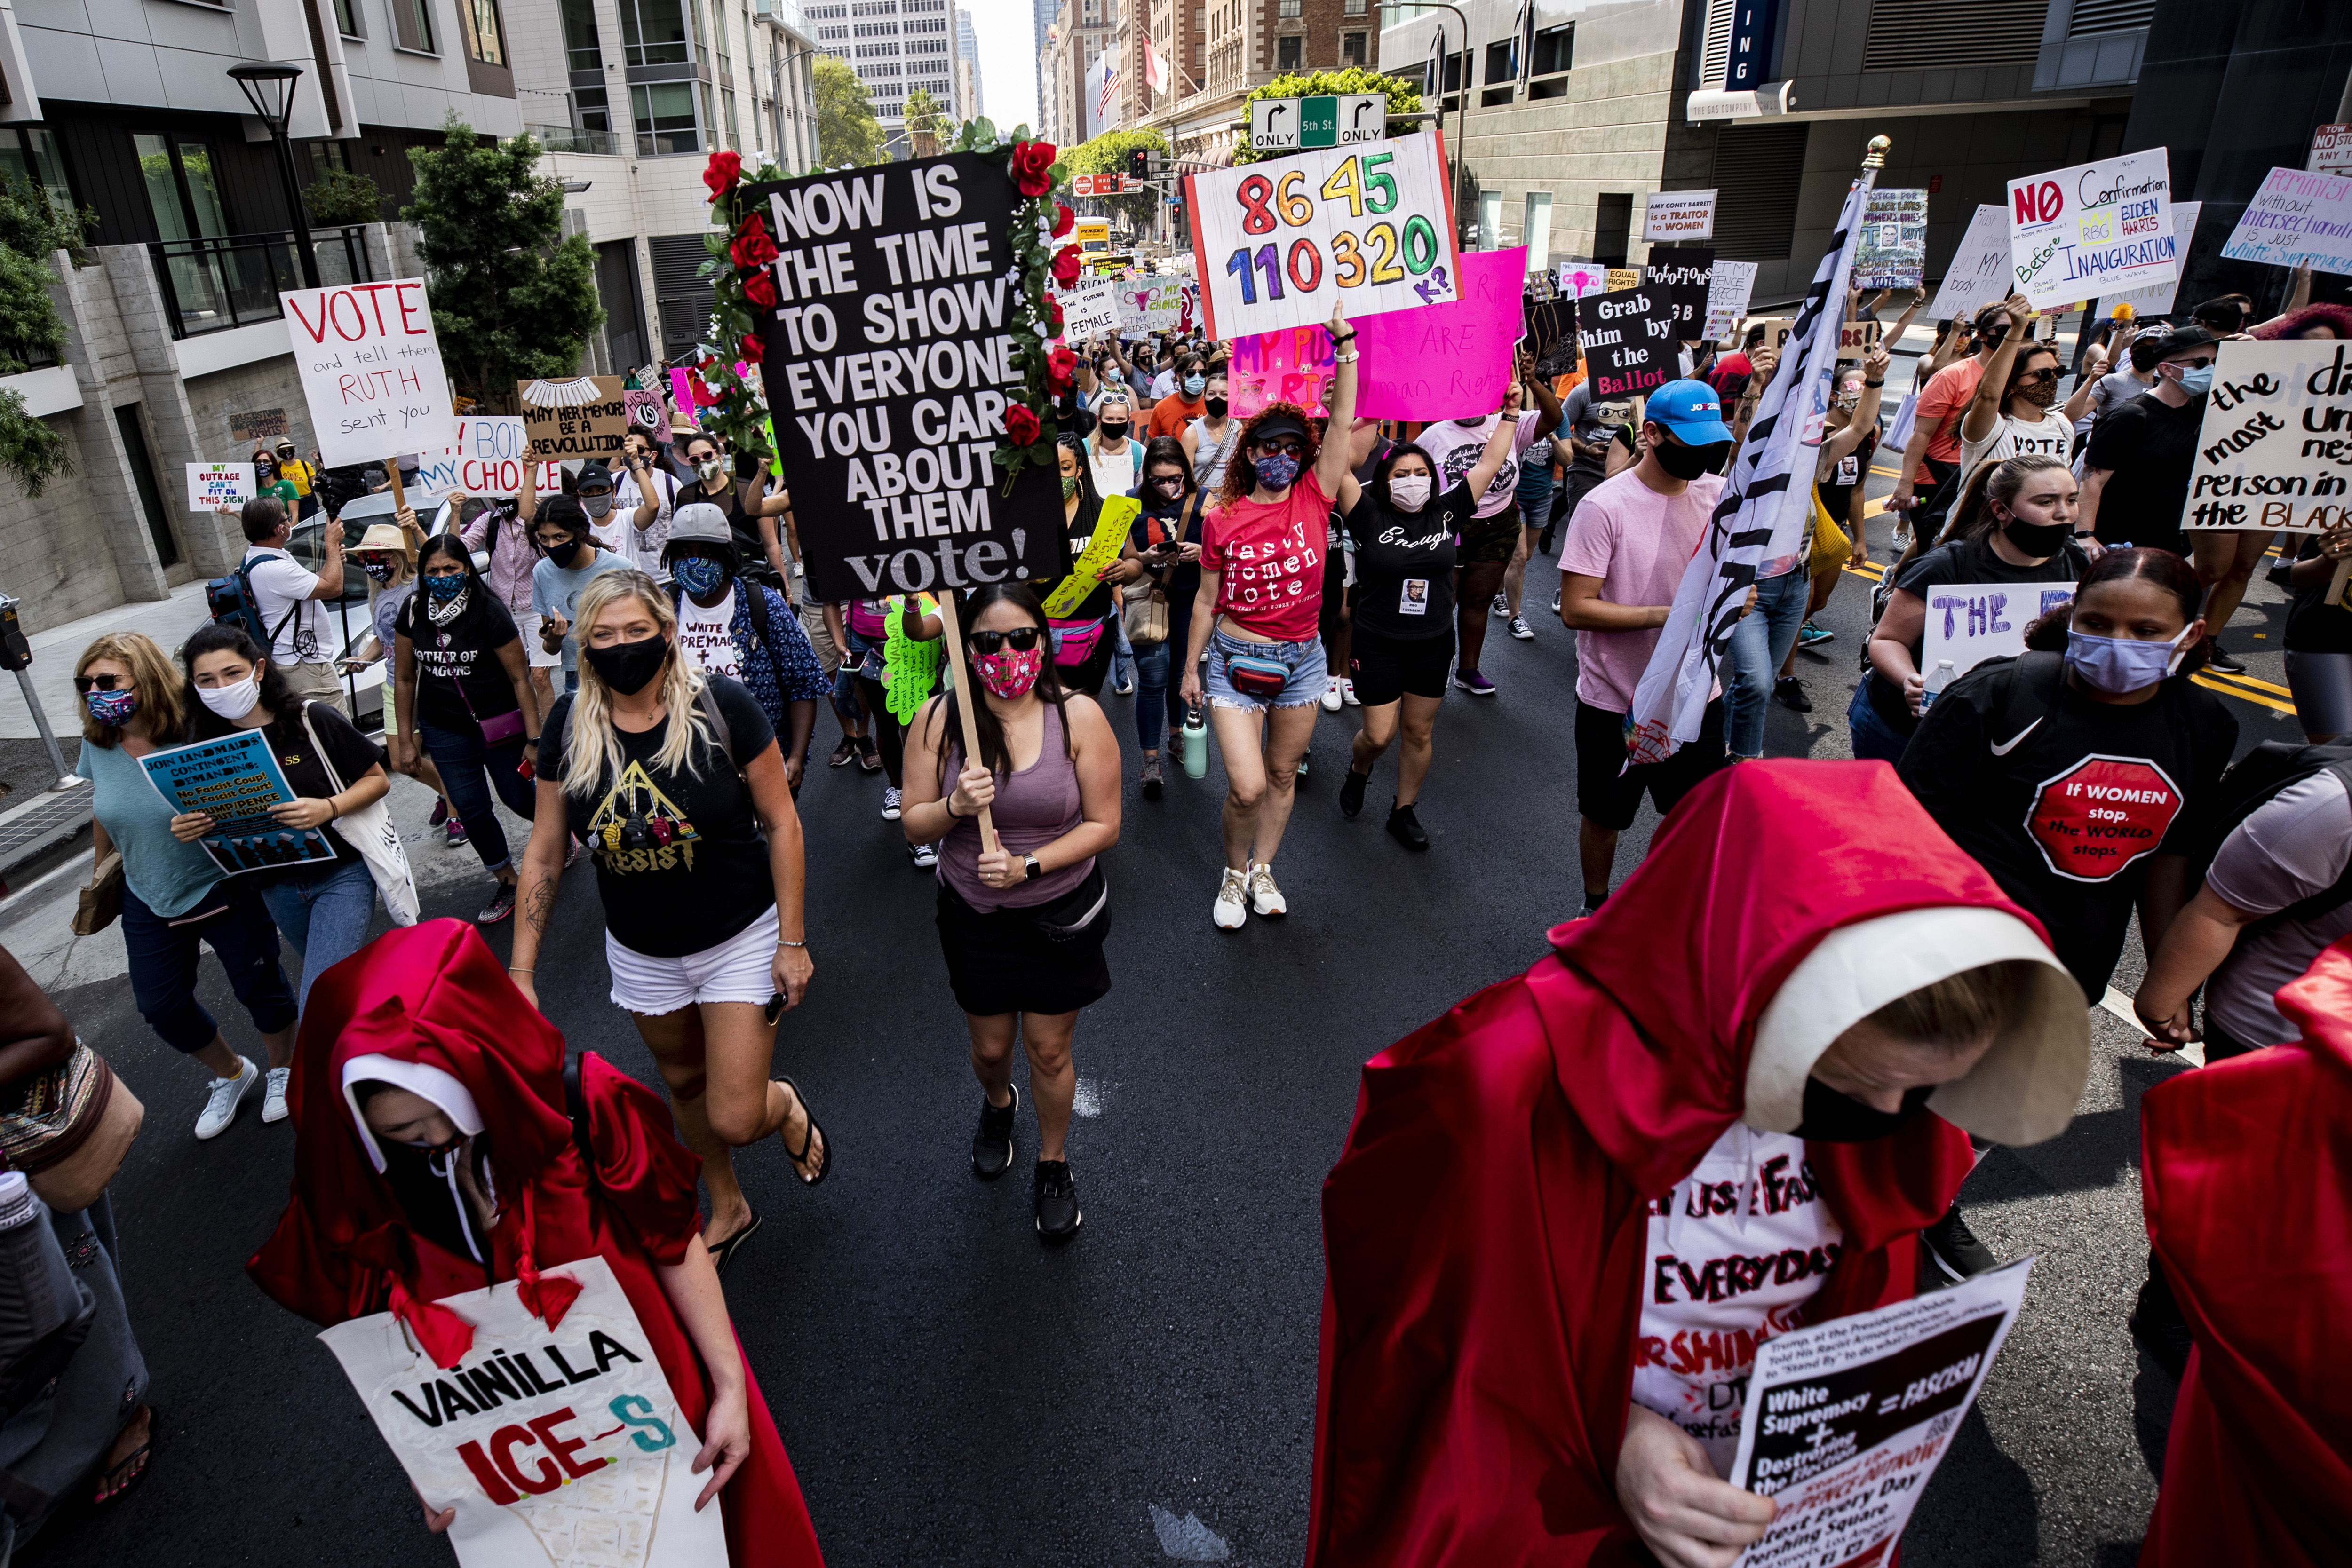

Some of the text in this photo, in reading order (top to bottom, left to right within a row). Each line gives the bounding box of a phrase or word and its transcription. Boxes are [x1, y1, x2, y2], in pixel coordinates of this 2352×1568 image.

[1694, 100, 1779, 115] THE GAS COMPANY TOWER
[1303, 119, 1335, 131] 5th St.
[1343, 129, 1381, 142] ONLY
[1256, 134, 1294, 146] ONLY
[2314, 135, 2335, 148] NO
[2317, 152, 2339, 160] ANY
[769, 165, 961, 243] NOW IS
[1237, 152, 1398, 234] 86 45
[2014, 170, 2167, 225] NO Confirmation
[1650, 212, 1658, 221] is
[1670, 210, 1708, 220] TRAITOR
[1870, 202, 1921, 211] BLACK LIVES
[2122, 198, 2159, 221] BIDEN
[1665, 221, 1704, 230] WOMEN
[1979, 214, 1997, 226] last
[2122, 216, 2159, 236] HARRIS
[1901, 227, 1926, 241] RUTH
[2082, 223, 2110, 241] RBG
[771, 222, 992, 300] THE TIME
[1226, 214, 1438, 305] 110 320
[2016, 236, 2175, 284] Before INAUGURATION
[2225, 241, 2271, 260] White
[1647, 263, 1712, 285] notorious
[1733, 263, 1755, 277] MY
[1977, 252, 2008, 277] MY
[1118, 283, 1135, 293] MY
[1141, 277, 1170, 290] BODY
[1164, 284, 1180, 295] MY
[1413, 266, 1450, 305] K?
[1871, 276, 1896, 287] VOTE
[1979, 277, 1999, 293] not
[2034, 279, 2053, 289] DUMP
[2099, 276, 2121, 284] BLUE
[1061, 291, 1105, 309] THE FUTURE
[1149, 297, 1182, 311] CHOICE
[1599, 293, 1651, 320] Grab
[288, 283, 427, 344] VOTE
[777, 279, 1006, 355] TO SHOW
[1071, 312, 1112, 335] FEMALE
[1420, 325, 1477, 355] ARE
[1581, 317, 1671, 348] him by
[314, 344, 434, 371] and tell them
[1234, 331, 1281, 373] MY
[1612, 345, 1649, 368] the
[637, 366, 651, 379] BOYS
[786, 335, 1025, 410] EVERYONE
[1599, 367, 1667, 396] Ballot
[339, 365, 421, 405] RUTH
[2211, 372, 2279, 411] the
[523, 400, 626, 423] MAY HER MEMORY
[626, 392, 661, 413] HISTORY
[643, 405, 655, 422] IS
[341, 412, 387, 434] sent
[560, 420, 592, 435] BE A
[796, 406, 890, 459] YOU
[532, 435, 626, 454] REVOLUTION
[2013, 435, 2065, 454] VOTE
[2203, 411, 2285, 466] most
[1448, 447, 1478, 463] Confident
[420, 460, 458, 490] MY
[847, 442, 999, 502] ABOUT
[1495, 473, 1513, 491] Queen
[2312, 471, 2347, 496] in
[864, 489, 992, 541] THEM
[2192, 501, 2352, 530] the BLACK
[1379, 520, 1452, 550] Enough.
[844, 529, 1028, 592] vote!
[1058, 518, 1119, 596] OWN the Rights
[1227, 547, 1318, 580] Women
[1227, 579, 1302, 603] Vote
[686, 622, 723, 633] WHITE
[1932, 593, 2011, 640] THE
[460, 650, 477, 662] OF
[889, 622, 902, 707] Having VAGINA
[147, 757, 175, 771] JOIN
[170, 751, 249, 776] CONTINGENT
[173, 761, 259, 787] DEMANDING:
[176, 772, 268, 799] No Fascist Coup!
[181, 781, 273, 808] No Fascist Court!
[2066, 783, 2167, 804] If WOMEN
[211, 811, 234, 822] OUT
[236, 804, 271, 817] NOW!
[2089, 807, 2130, 822] stop,
[2049, 820, 2153, 839] the WORLD
[592, 836, 702, 876] RESIST
[2073, 843, 2120, 859] stops.
[1770, 1340, 1851, 1366] Told His Racist
[1767, 1352, 1981, 1412] White FASCISM
[1763, 1391, 1871, 1436] Supremacy
[1756, 1430, 1857, 1477] Destroying
[1753, 1443, 1859, 1497] the Election
[1814, 1472, 1921, 1524] Every Day
[1824, 1503, 1889, 1537] Square
